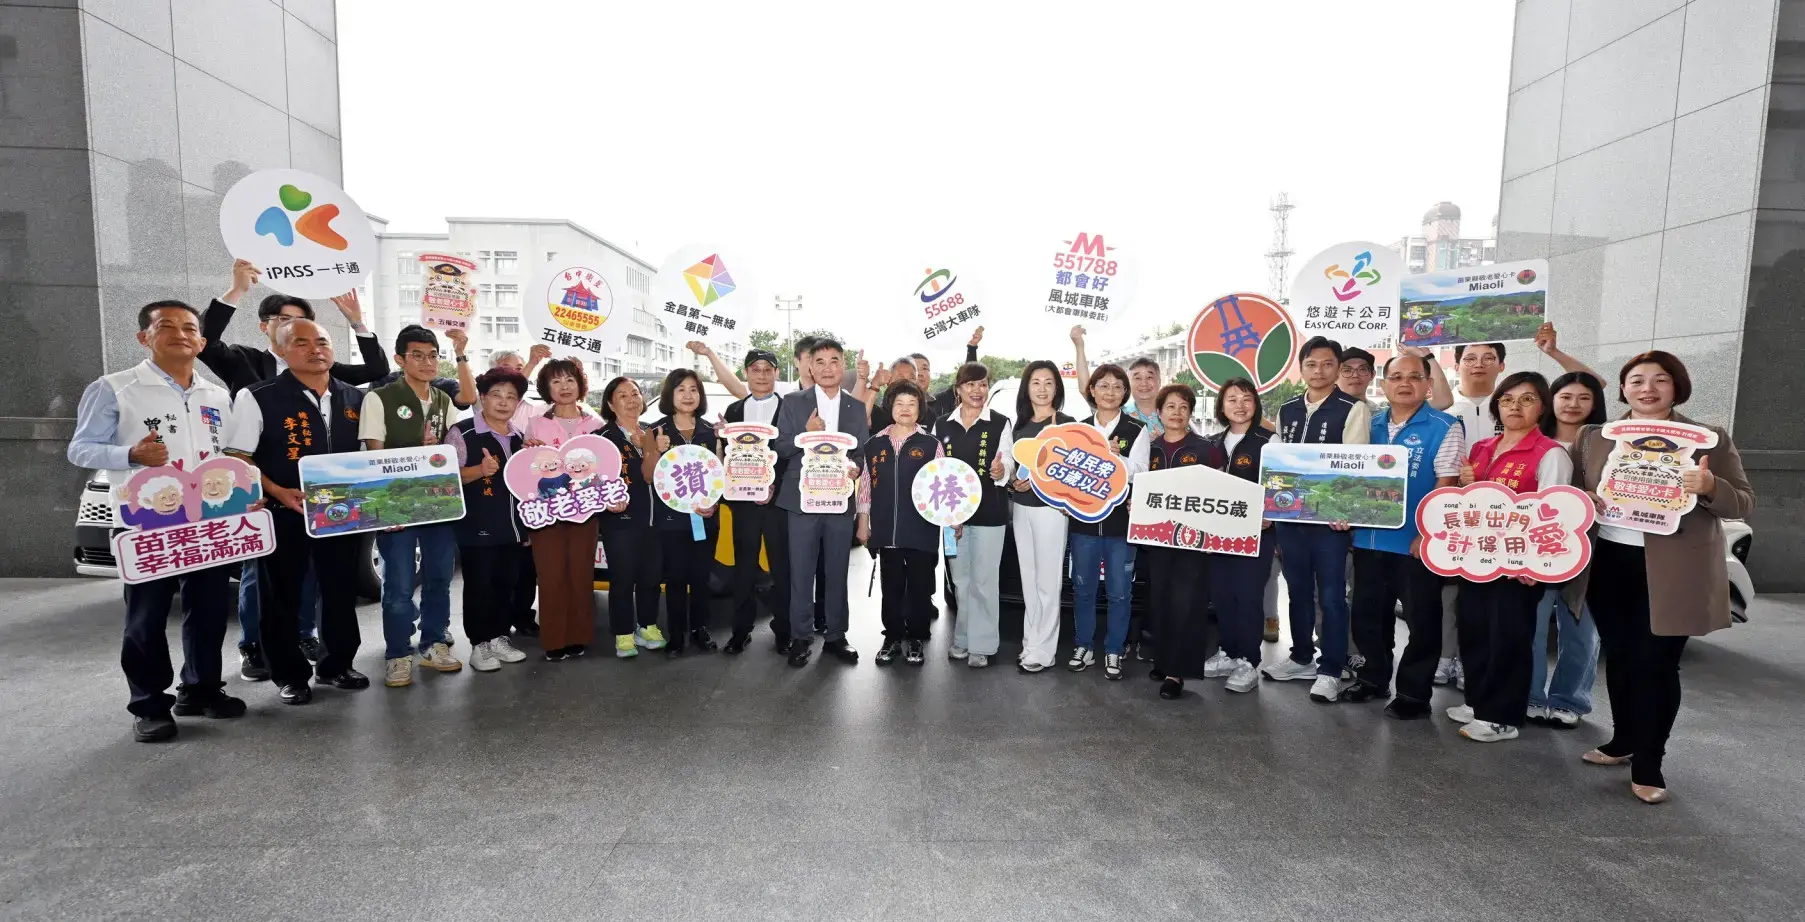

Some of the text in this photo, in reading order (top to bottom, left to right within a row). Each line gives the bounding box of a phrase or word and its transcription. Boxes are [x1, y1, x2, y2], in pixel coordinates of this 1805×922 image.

[266, 262, 360, 279] iPASS 一卡通
[1053, 252, 1117, 276] 551788
[1056, 270, 1109, 291] 都會好
[1469, 280, 1504, 291] Miaoli
[925, 293, 964, 319] 55688
[1048, 288, 1109, 311] 風城車隊
[554, 307, 599, 326] 22465555
[664, 301, 736, 330] 金昌第一無線
[924, 304, 981, 339] 台灣大車隊
[1307, 306, 1391, 318] 悠遊卡公司
[542, 327, 602, 353] 五權交通
[684, 321, 709, 336] 車隊
[165, 413, 178, 434] 秘書
[283, 417, 301, 459] 李文星
[382, 463, 418, 473] Miaoli
[1330, 460, 1364, 470] Miaoli
[1410, 447, 1424, 478] 立法委員
[1514, 463, 1527, 477] 立委
[671, 461, 709, 499] 讚
[1047, 462, 1111, 499] 65歲以上
[522, 481, 626, 526] 敬老愛老
[928, 474, 967, 512] 棒
[1146, 492, 1248, 518] 原住民55歲
[1443, 510, 1531, 533] 長輩出門
[130, 516, 261, 556] 苗栗老人
[135, 533, 264, 574] 幸福滿滿
[1508, 558, 1523, 566] iung
